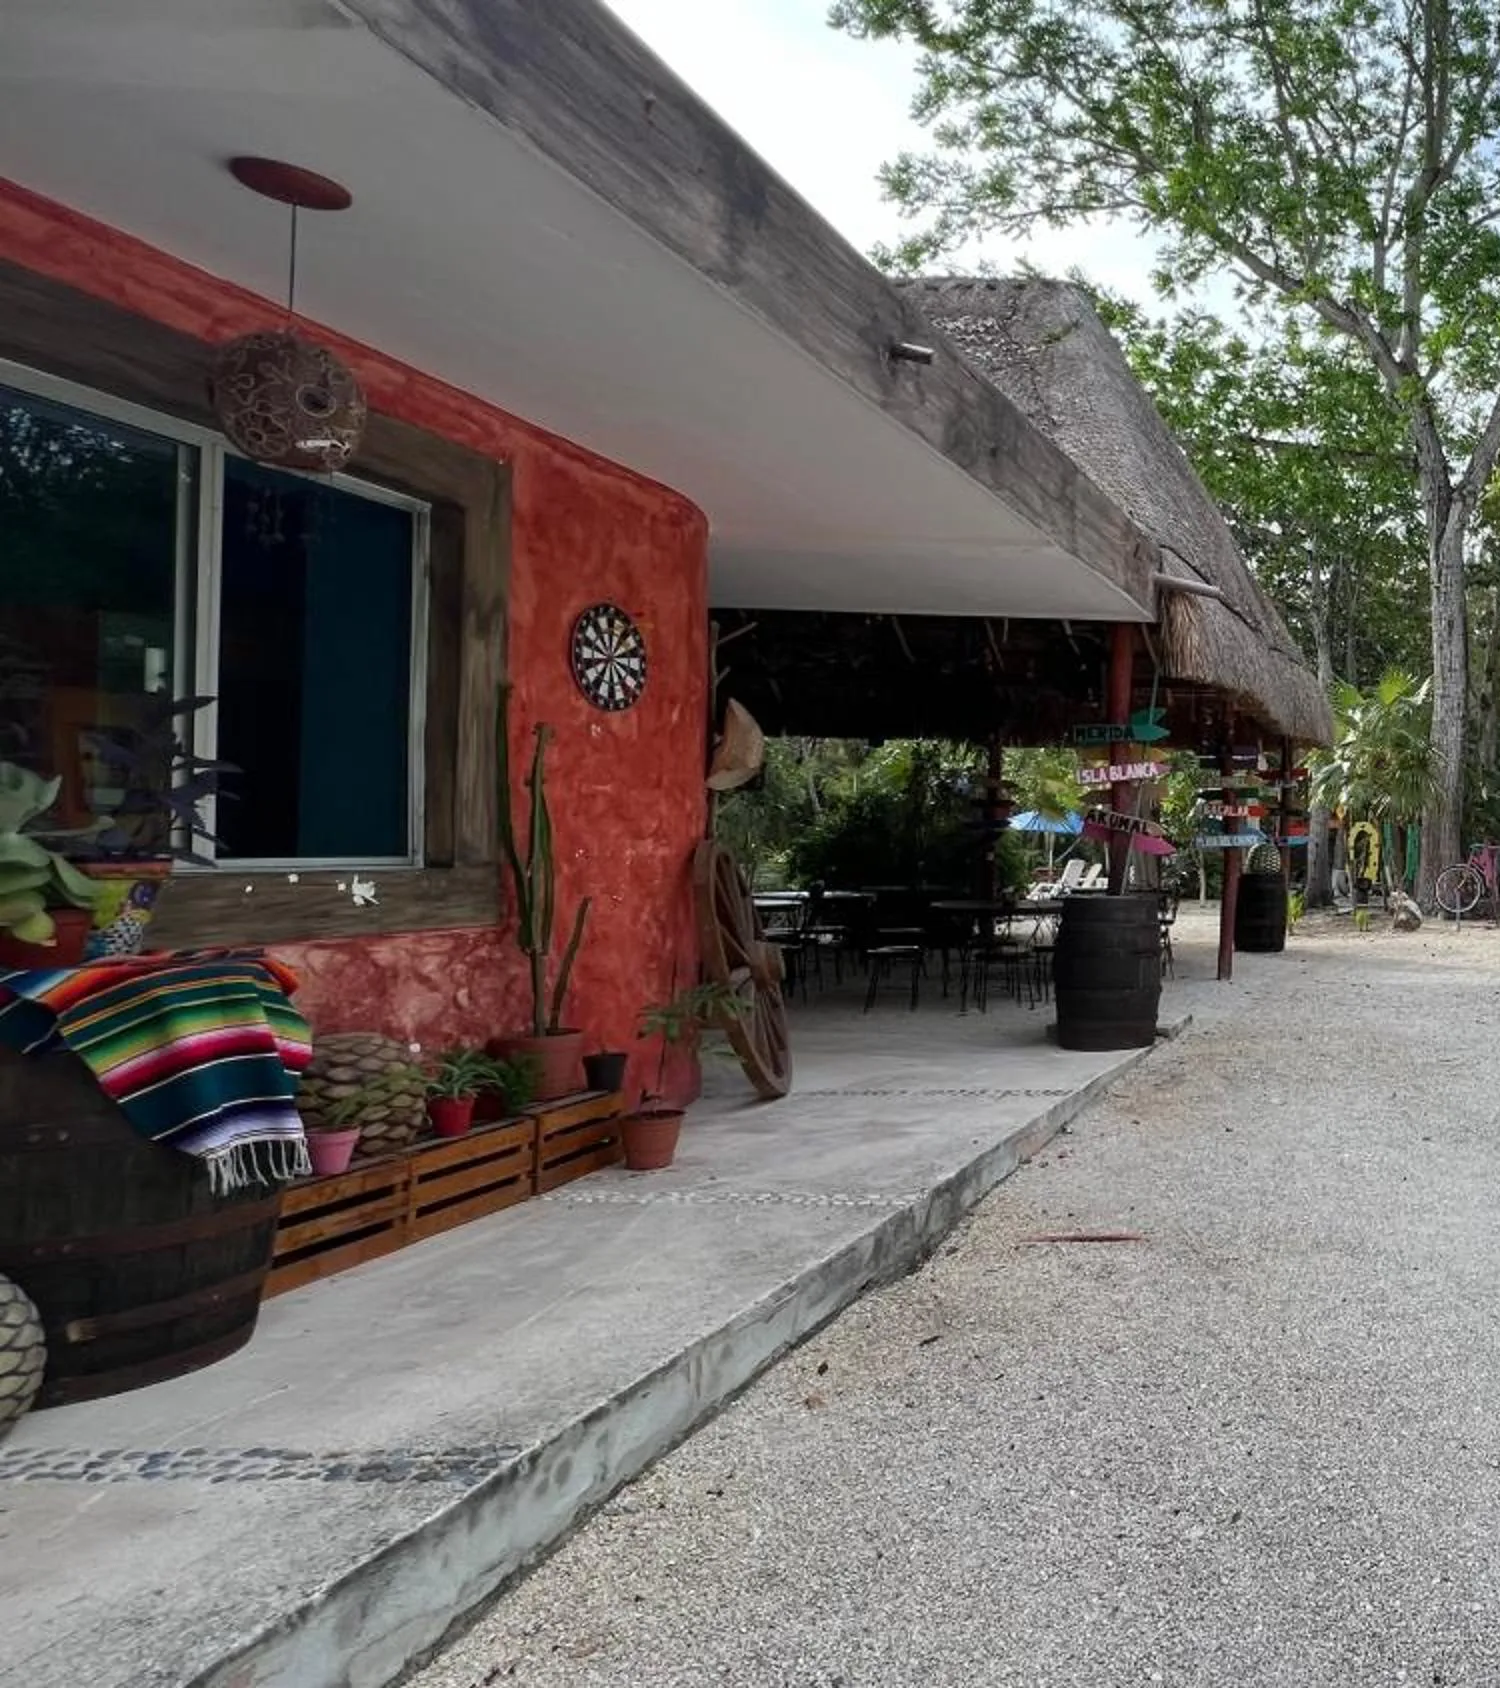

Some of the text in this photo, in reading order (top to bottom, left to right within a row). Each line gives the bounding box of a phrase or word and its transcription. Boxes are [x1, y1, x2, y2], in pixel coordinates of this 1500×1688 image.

[1076, 726, 1135, 741] MERIDA
[1077, 761, 1157, 784] ISLA BLANCA
[1087, 809, 1149, 835] AKUMAL
